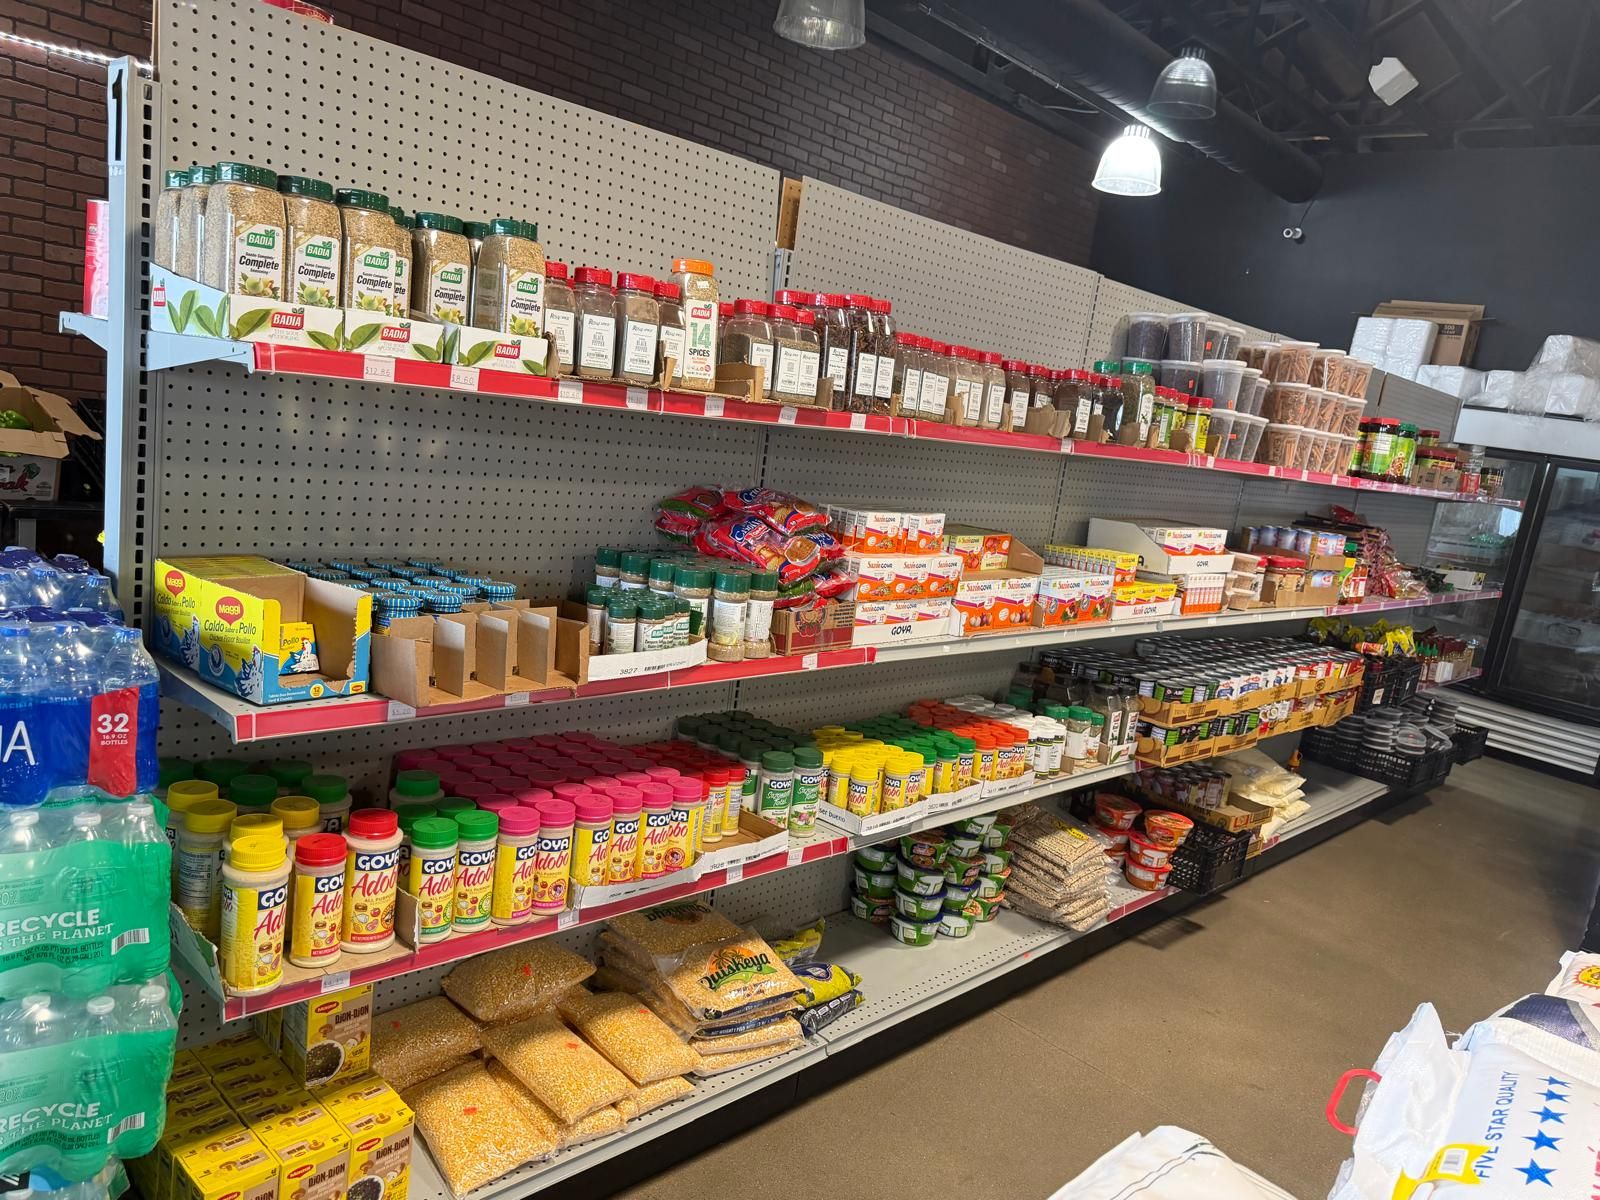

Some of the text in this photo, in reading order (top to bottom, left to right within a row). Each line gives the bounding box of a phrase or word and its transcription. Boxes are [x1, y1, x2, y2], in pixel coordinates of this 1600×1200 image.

[249, 234, 273, 246] BADIA
[307, 247, 331, 258] BADIA
[239, 255, 280, 270] Complete
[365, 257, 388, 267] BADIA
[298, 266, 336, 280] Complete
[441, 271, 462, 282] BADIA
[356, 275, 393, 289] Complete
[518, 281, 537, 292] BADIA
[434, 289, 465, 302] Complete
[510, 299, 541, 313] Complete
[273, 314, 302, 327] BADIA
[383, 328, 408, 340] BADIA
[690, 322, 711, 348] 14
[495, 344, 520, 356] BADIA
[689, 348, 710, 357] SPICES
[167, 577, 184, 588] Maggi
[157, 593, 196, 608] Caldo Pollo
[219, 604, 241, 615] Maggi
[204, 619, 225, 632] Caldo
[239, 622, 256, 635] Pollo
[891, 625, 912, 635] GOYA
[283, 637, 299, 646] Pollo
[97, 713, 129, 733] 32
[850, 783, 867, 793] OYA
[885, 778, 901, 787] OYA
[460, 849, 495, 865] GOYA
[8, 922, 114, 947] THE PLANET
[80, 941, 104, 952] BOTTLES
[1495, 1071, 1520, 1106] QUALITY
[10, 1113, 113, 1139] THE PLANET
[1485, 1108, 1510, 1141] STAR
